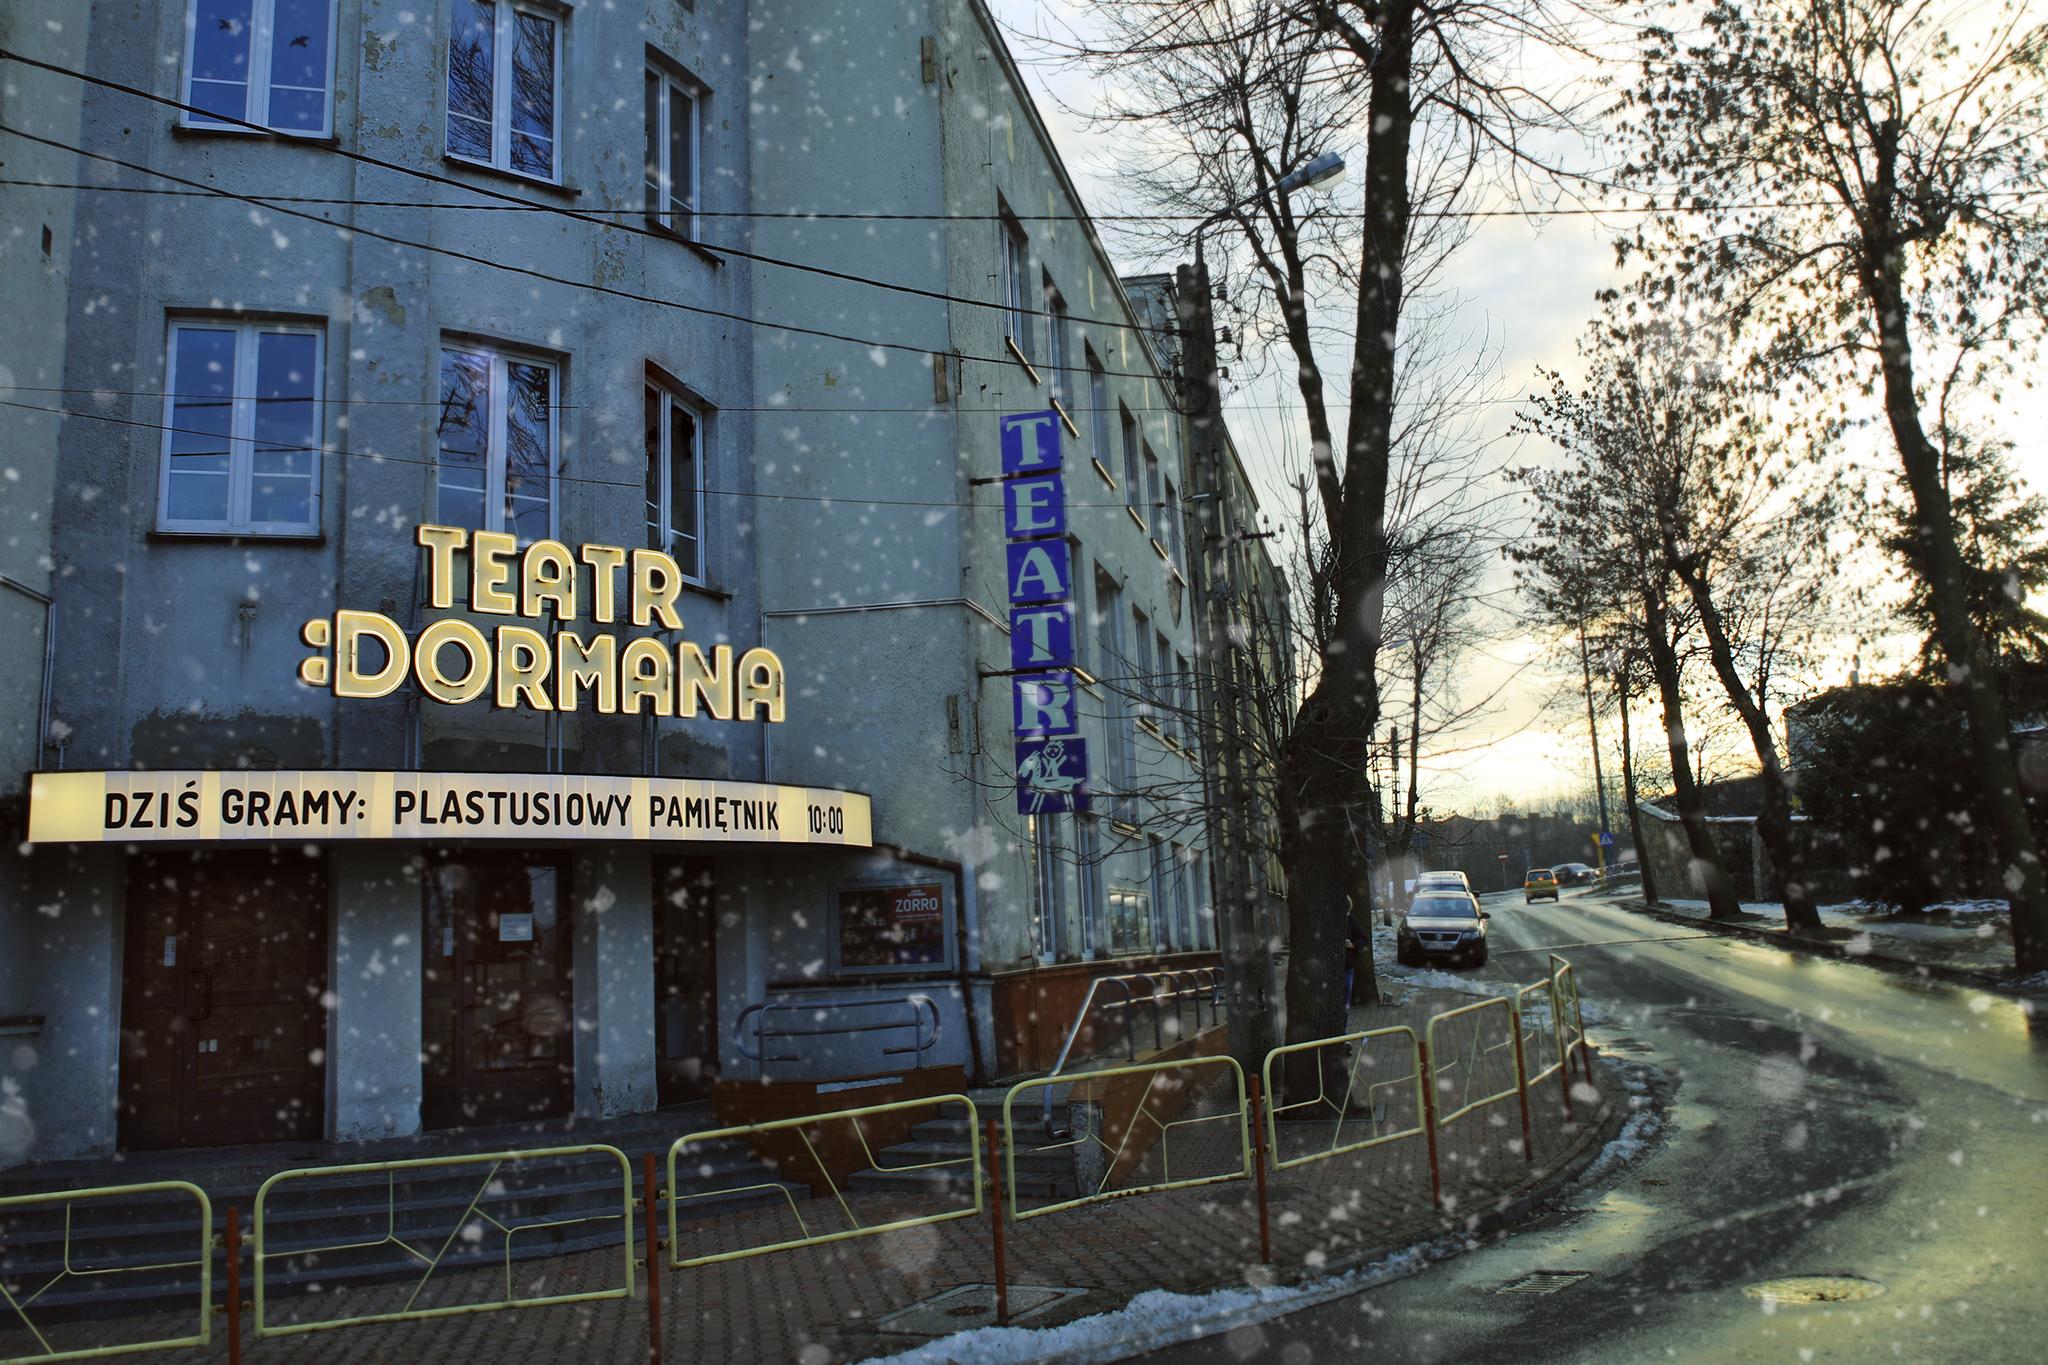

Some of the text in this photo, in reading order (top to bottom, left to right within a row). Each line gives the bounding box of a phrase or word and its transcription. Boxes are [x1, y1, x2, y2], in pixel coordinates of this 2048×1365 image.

[418, 524, 684, 630] TEATR
[1006, 417, 1070, 730] TEATR
[104, 780, 844, 836] DZIŚ GRAMY: PLASTUSIOWY PAMIĘTNIK 10:00
[895, 897, 938, 912] ZORRO
